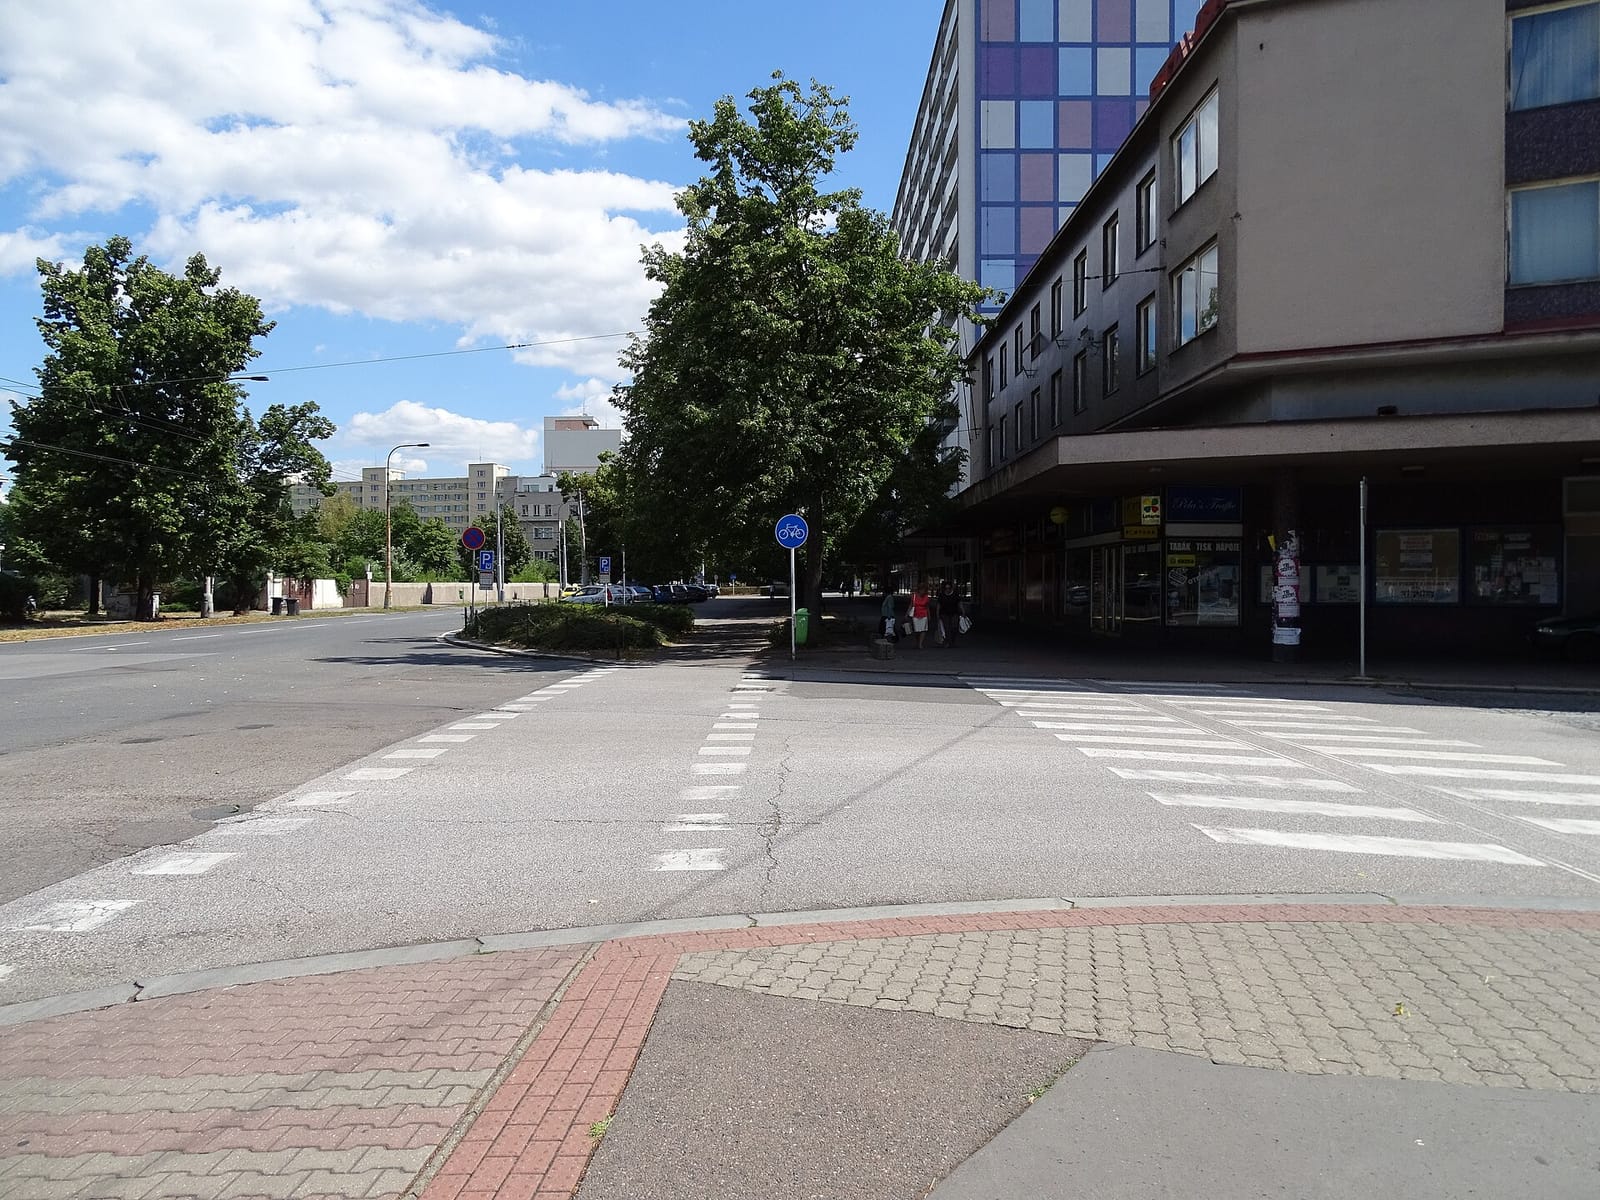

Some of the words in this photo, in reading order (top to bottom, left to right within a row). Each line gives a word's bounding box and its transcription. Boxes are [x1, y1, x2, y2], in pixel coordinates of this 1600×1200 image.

[1169, 540, 1191, 551] TABÁK
[1196, 542, 1212, 551] TISK
[1216, 541, 1240, 551] NÁPOJE
[482, 553, 491, 565] P
[601, 559, 608, 569] P
